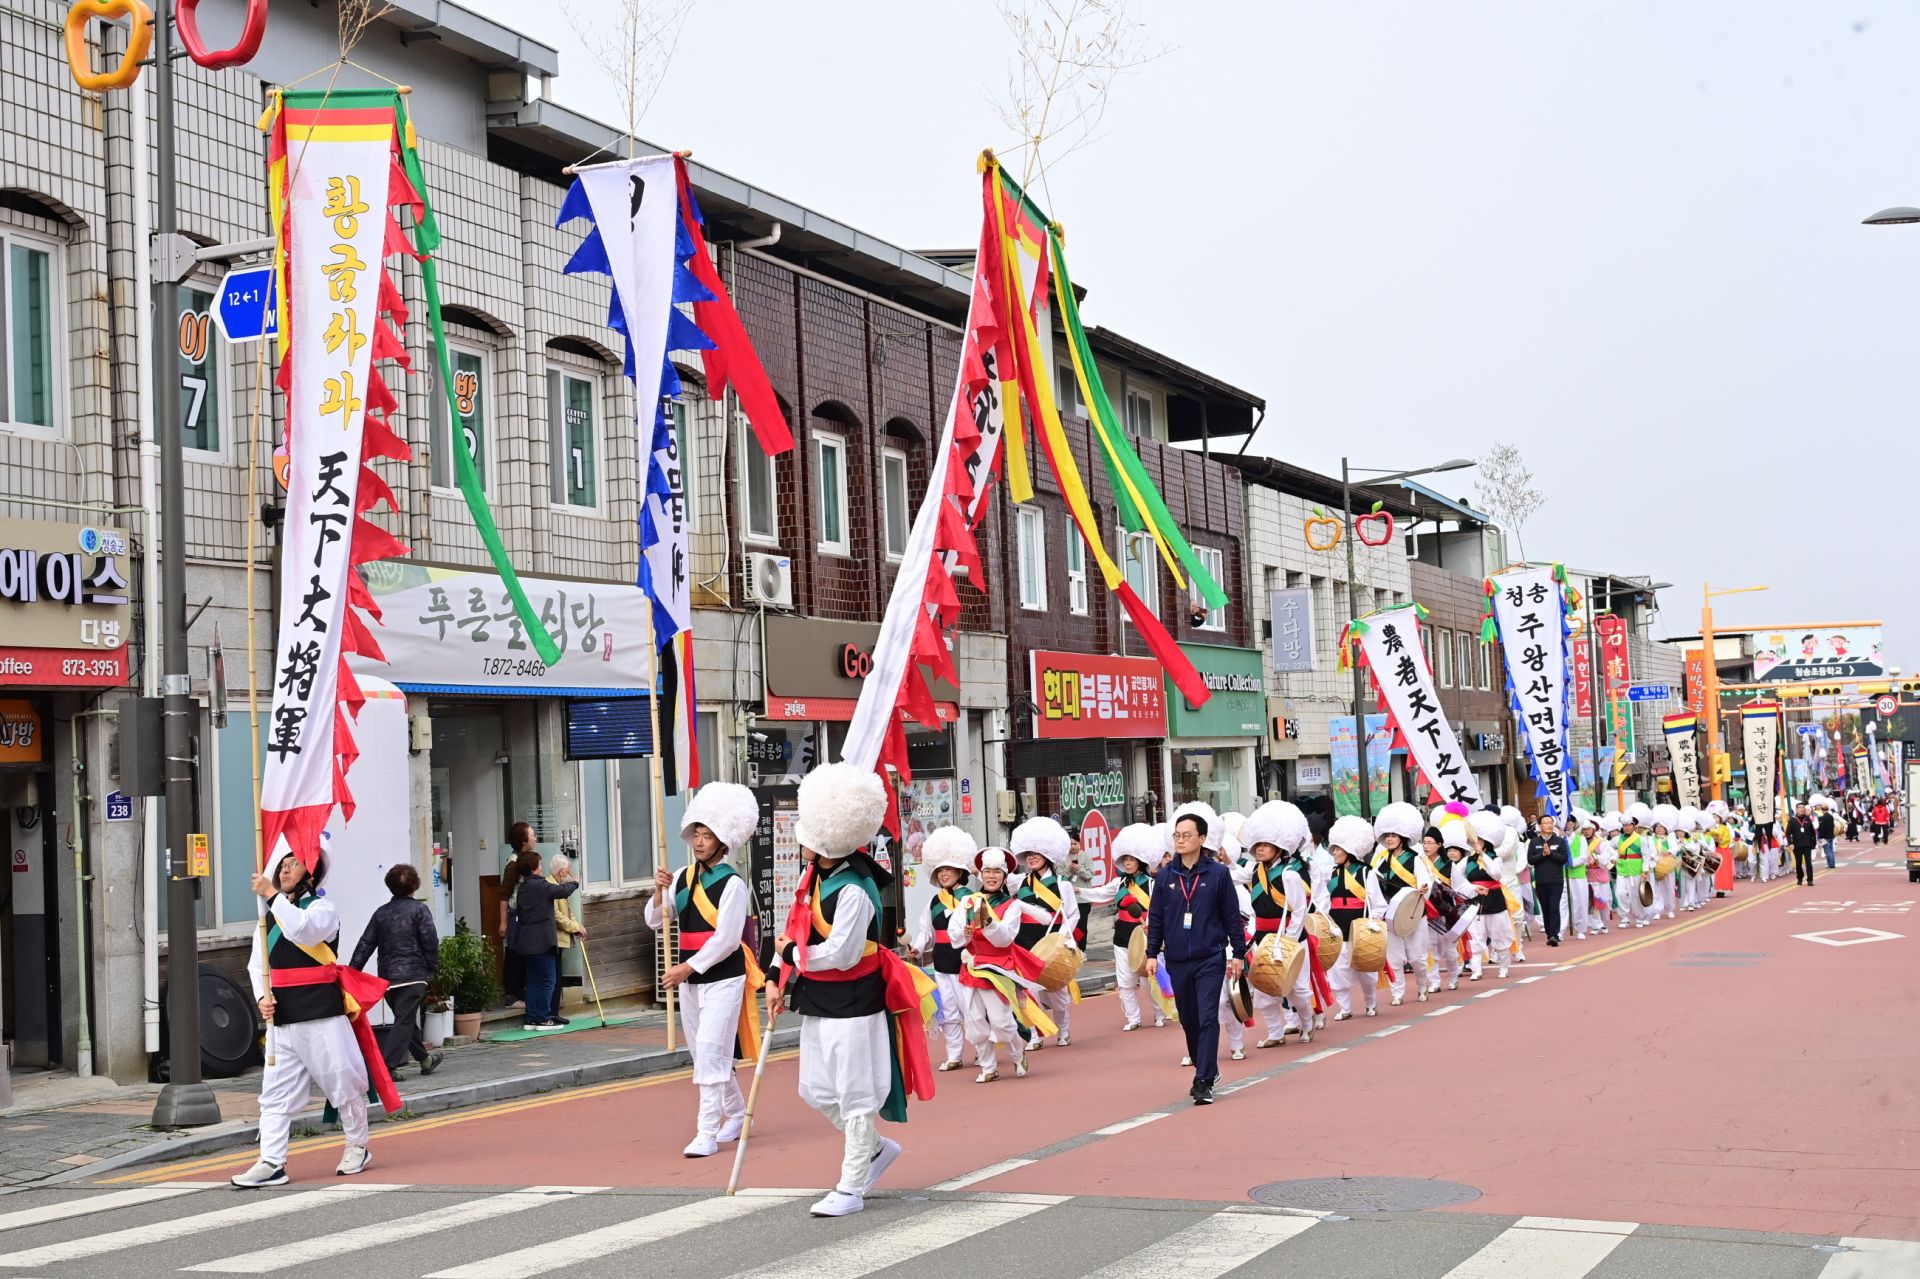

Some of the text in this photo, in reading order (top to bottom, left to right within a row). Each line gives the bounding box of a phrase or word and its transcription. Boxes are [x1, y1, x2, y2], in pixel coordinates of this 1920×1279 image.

[321, 177, 369, 430] 황금사과
[181, 374, 207, 430] 7
[454, 371, 478, 416] 방
[0, 548, 128, 606] 에이스
[1505, 583, 1549, 607] 청송
[267, 451, 350, 764] 天下大將軍
[81, 620, 120, 648] 다방
[1280, 598, 1302, 661] 수다방
[62, 659, 119, 676] 873-3951
[483, 657, 545, 677] T.872-8466
[1202, 672, 1261, 692] Nature Collection
[1881, 702, 1893, 710] 30
[1062, 771, 1124, 809] 873-3222
[111, 805, 128, 817] 238
[1083, 826, 1107, 887] 땅
